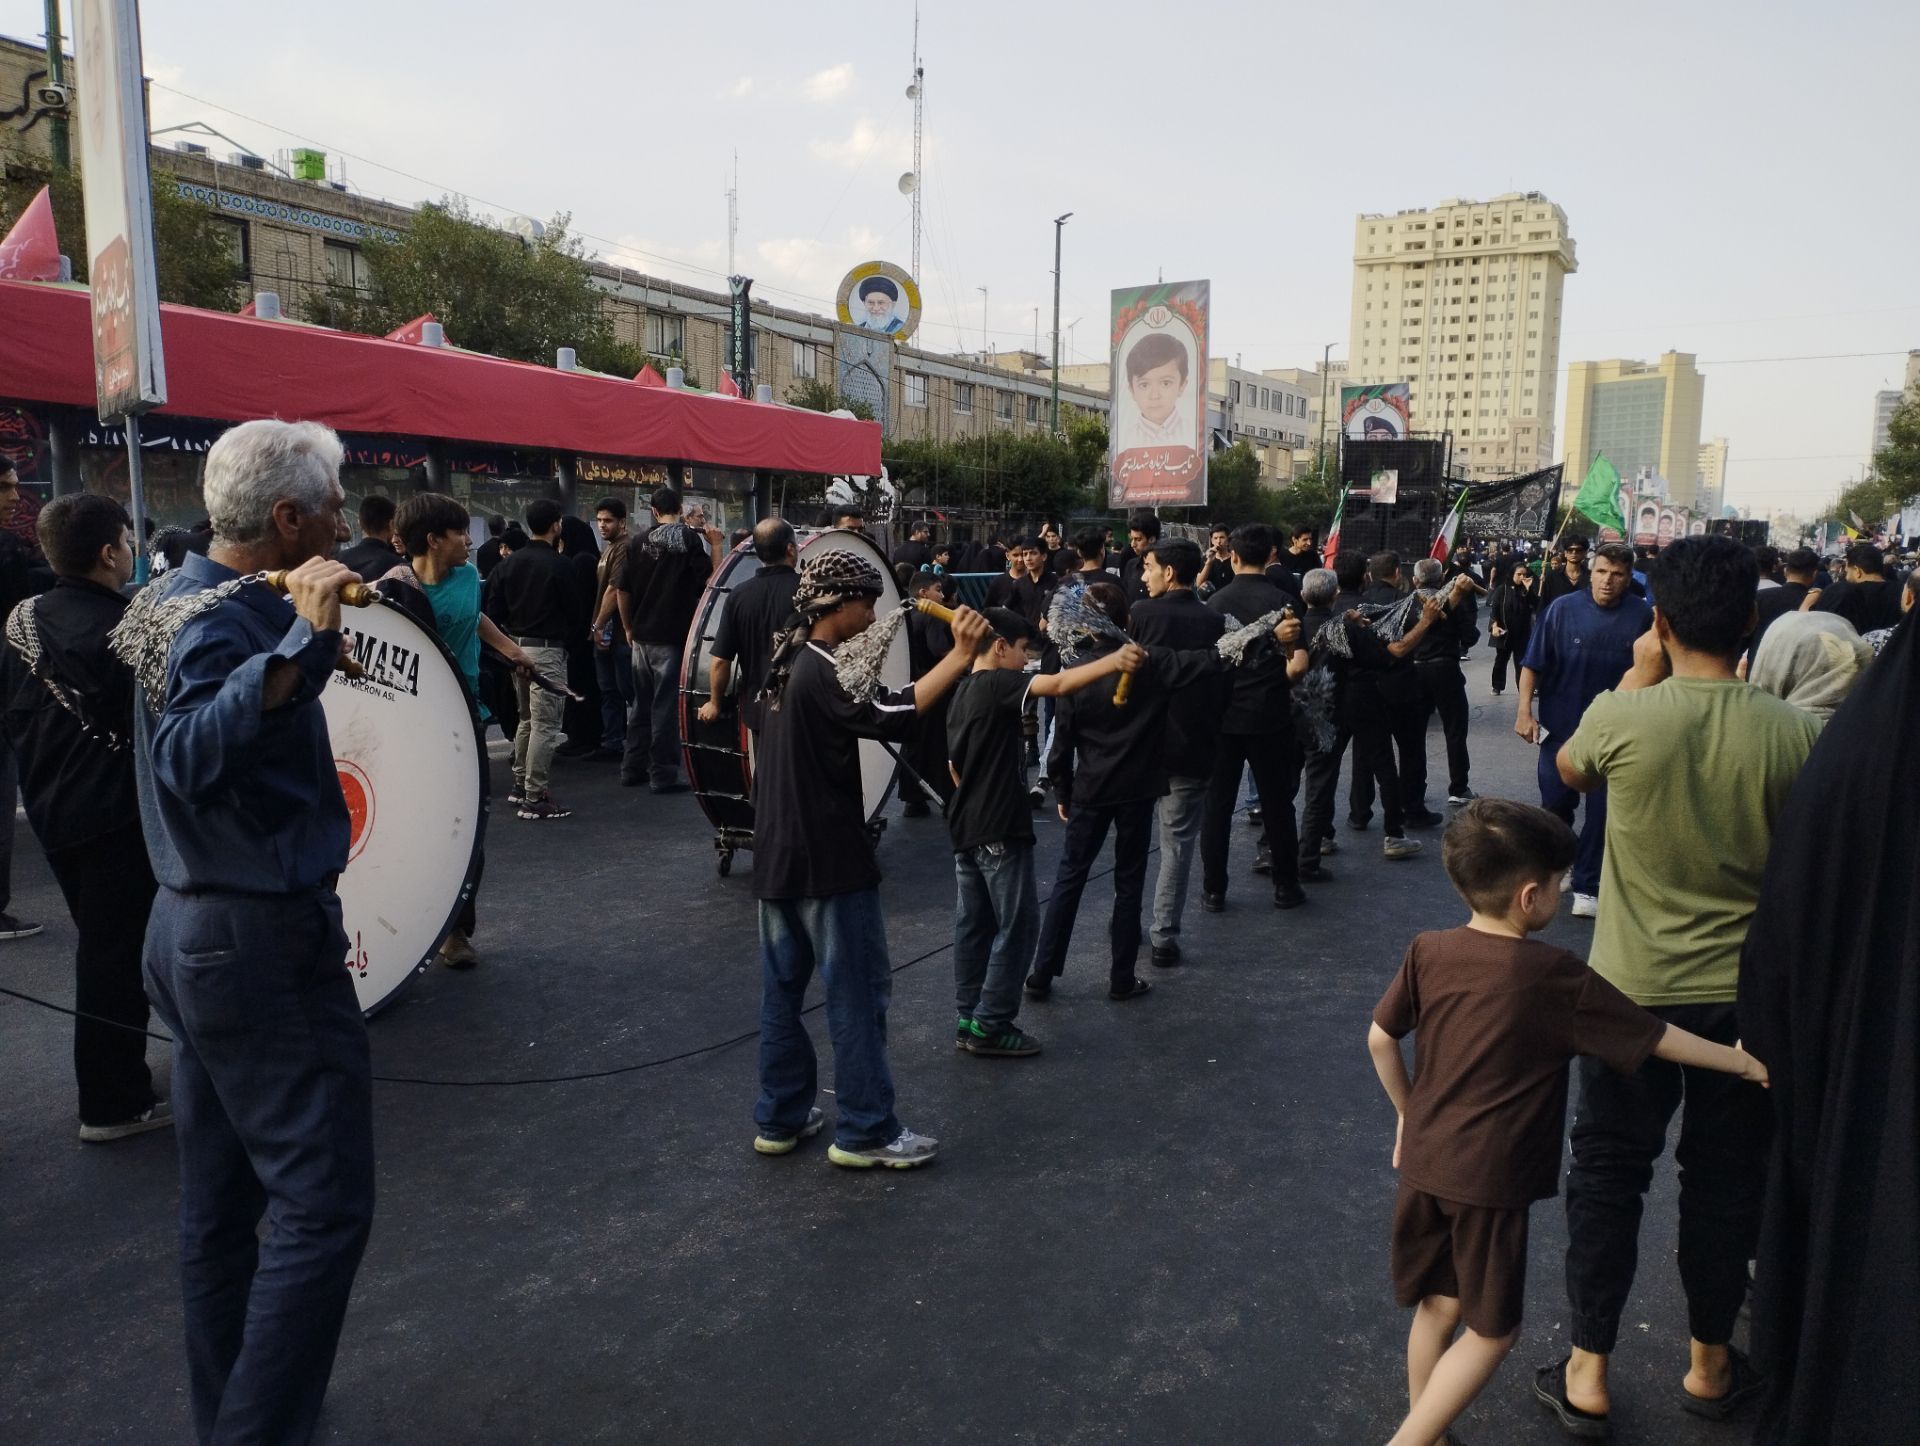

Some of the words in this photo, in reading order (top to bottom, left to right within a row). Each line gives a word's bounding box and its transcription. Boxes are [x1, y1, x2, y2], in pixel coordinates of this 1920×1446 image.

[1164, 454, 1195, 476] نایب
[343, 626, 420, 697] MAHA
[350, 678, 381, 697] MICRON
